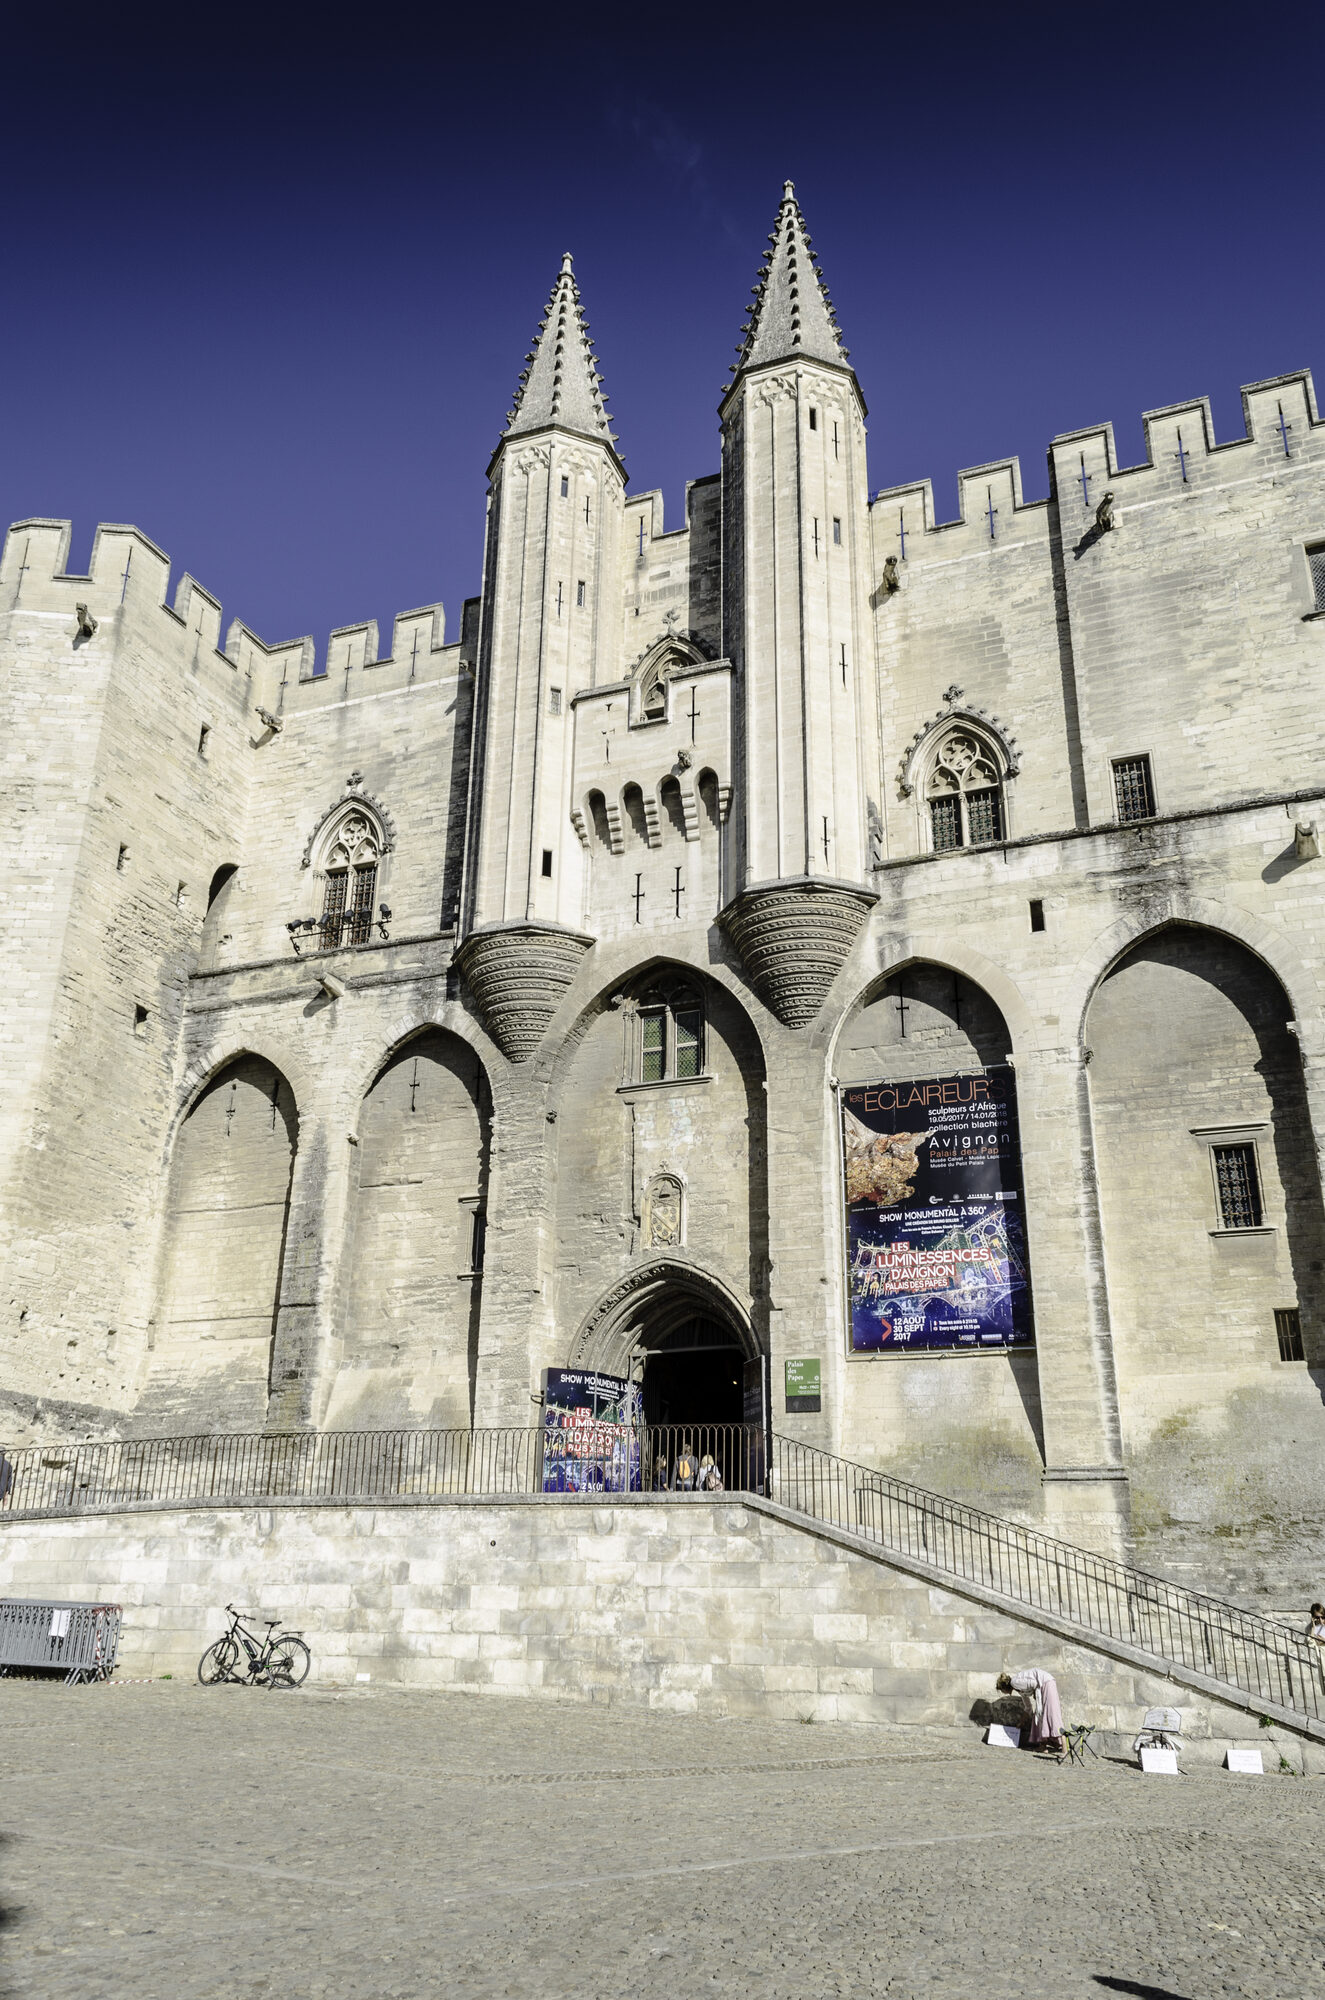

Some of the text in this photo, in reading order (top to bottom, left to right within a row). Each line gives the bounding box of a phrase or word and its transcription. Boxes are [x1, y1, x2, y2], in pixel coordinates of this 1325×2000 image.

[849, 1078, 1006, 1112] les ECLAIREURS
[928, 1101, 1007, 1117] sculpteurs d'Afrique
[929, 1114, 965, 1123] 19.05/2017
[928, 1122, 969, 1132] collection
[929, 1132, 1010, 1149] Avignon
[930, 1150, 957, 1158] Palais
[960, 1148, 978, 1156] des
[879, 1213, 903, 1223] SHOW
[904, 1208, 959, 1221] MONUMENTAL
[892, 1242, 909, 1253] LES
[878, 1248, 990, 1268] LUMINESSENCES
[891, 1264, 955, 1280] D'AVIGNON
[885, 1278, 948, 1291] PALAIS DES PAPES
[893, 1315, 926, 1325] 12 AOÛT
[893, 1324, 924, 1333] 30 SEPT
[893, 1332, 911, 1341] 2017
[560, 1374, 583, 1384] SHOW
[576, 1407, 591, 1417] LES
